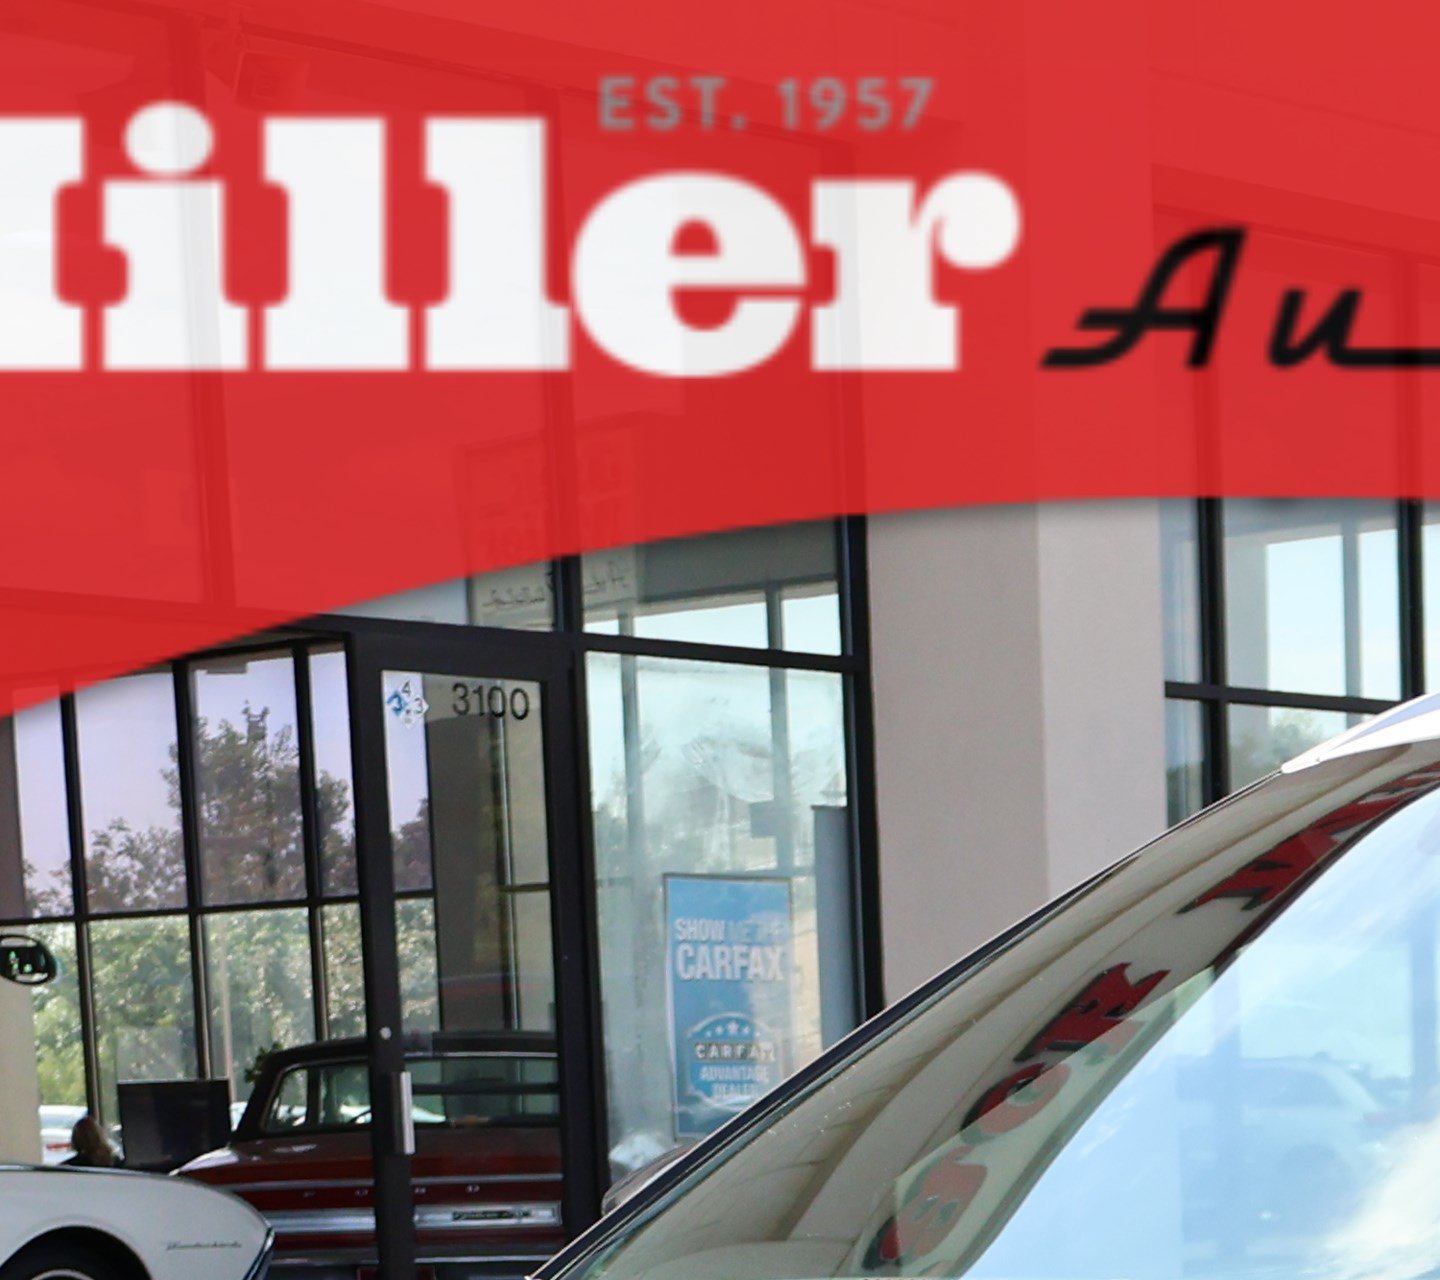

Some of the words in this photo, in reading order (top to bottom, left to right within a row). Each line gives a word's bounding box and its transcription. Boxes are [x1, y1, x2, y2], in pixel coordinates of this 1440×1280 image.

[452, 682, 530, 721] 3100
[675, 918, 725, 942] SHOW
[677, 943, 784, 981] CARFAX
